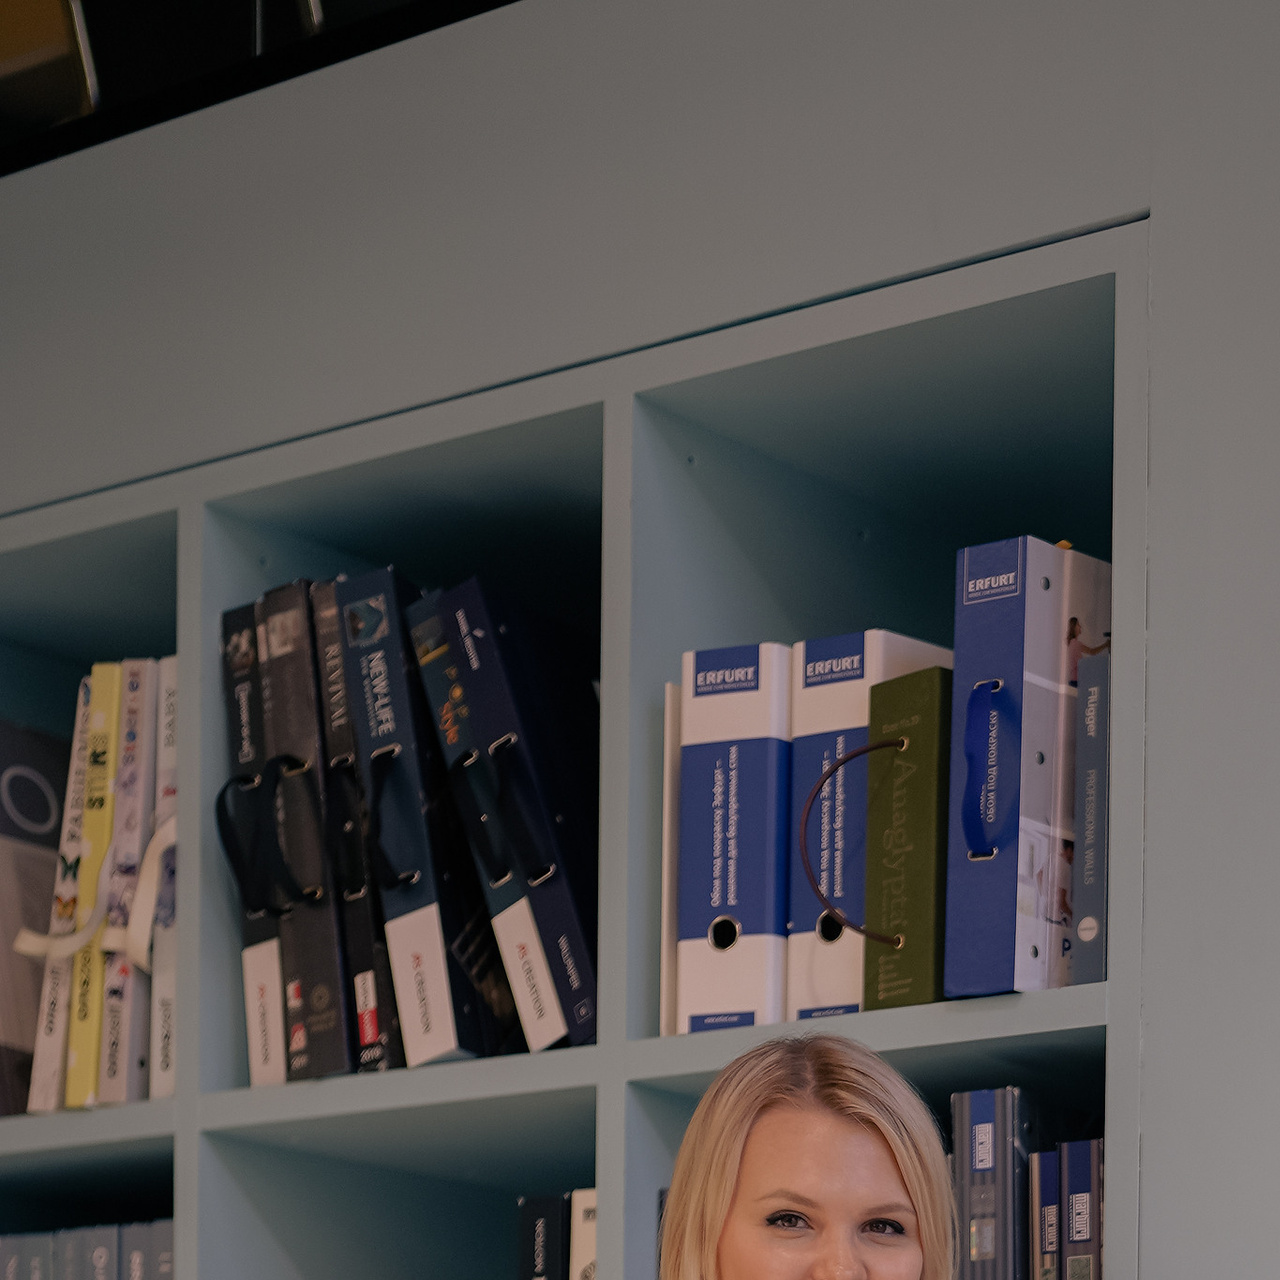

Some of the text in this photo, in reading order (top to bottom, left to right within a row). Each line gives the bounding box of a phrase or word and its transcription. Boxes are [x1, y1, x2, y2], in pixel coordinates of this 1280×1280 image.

[968, 570, 1018, 593] ERFURT
[325, 643, 348, 733] REVIVAL
[697, 665, 757, 687] ERFURT
[805, 653, 861, 678] ERFURT
[1085, 686, 1100, 738] Flügger
[835, 735, 846, 759] стен
[985, 709, 999, 823] ОБОИ ПОД ПОКРАСКУ
[713, 808, 725, 857] покраску
[726, 745, 740, 907] решения для безупречных стен
[821, 800, 832, 849] покраску
[834, 831, 844, 850] для
[1082, 769, 1097, 886] PROFESSIONAL WALLS
[711, 857, 722, 879] под
[820, 849, 830, 870] под
[833, 850, 844, 898] решения
[710, 879, 722, 908] Обои
[1045, 1204, 1058, 1252] marburg
[1072, 1192, 1090, 1241] marburg
